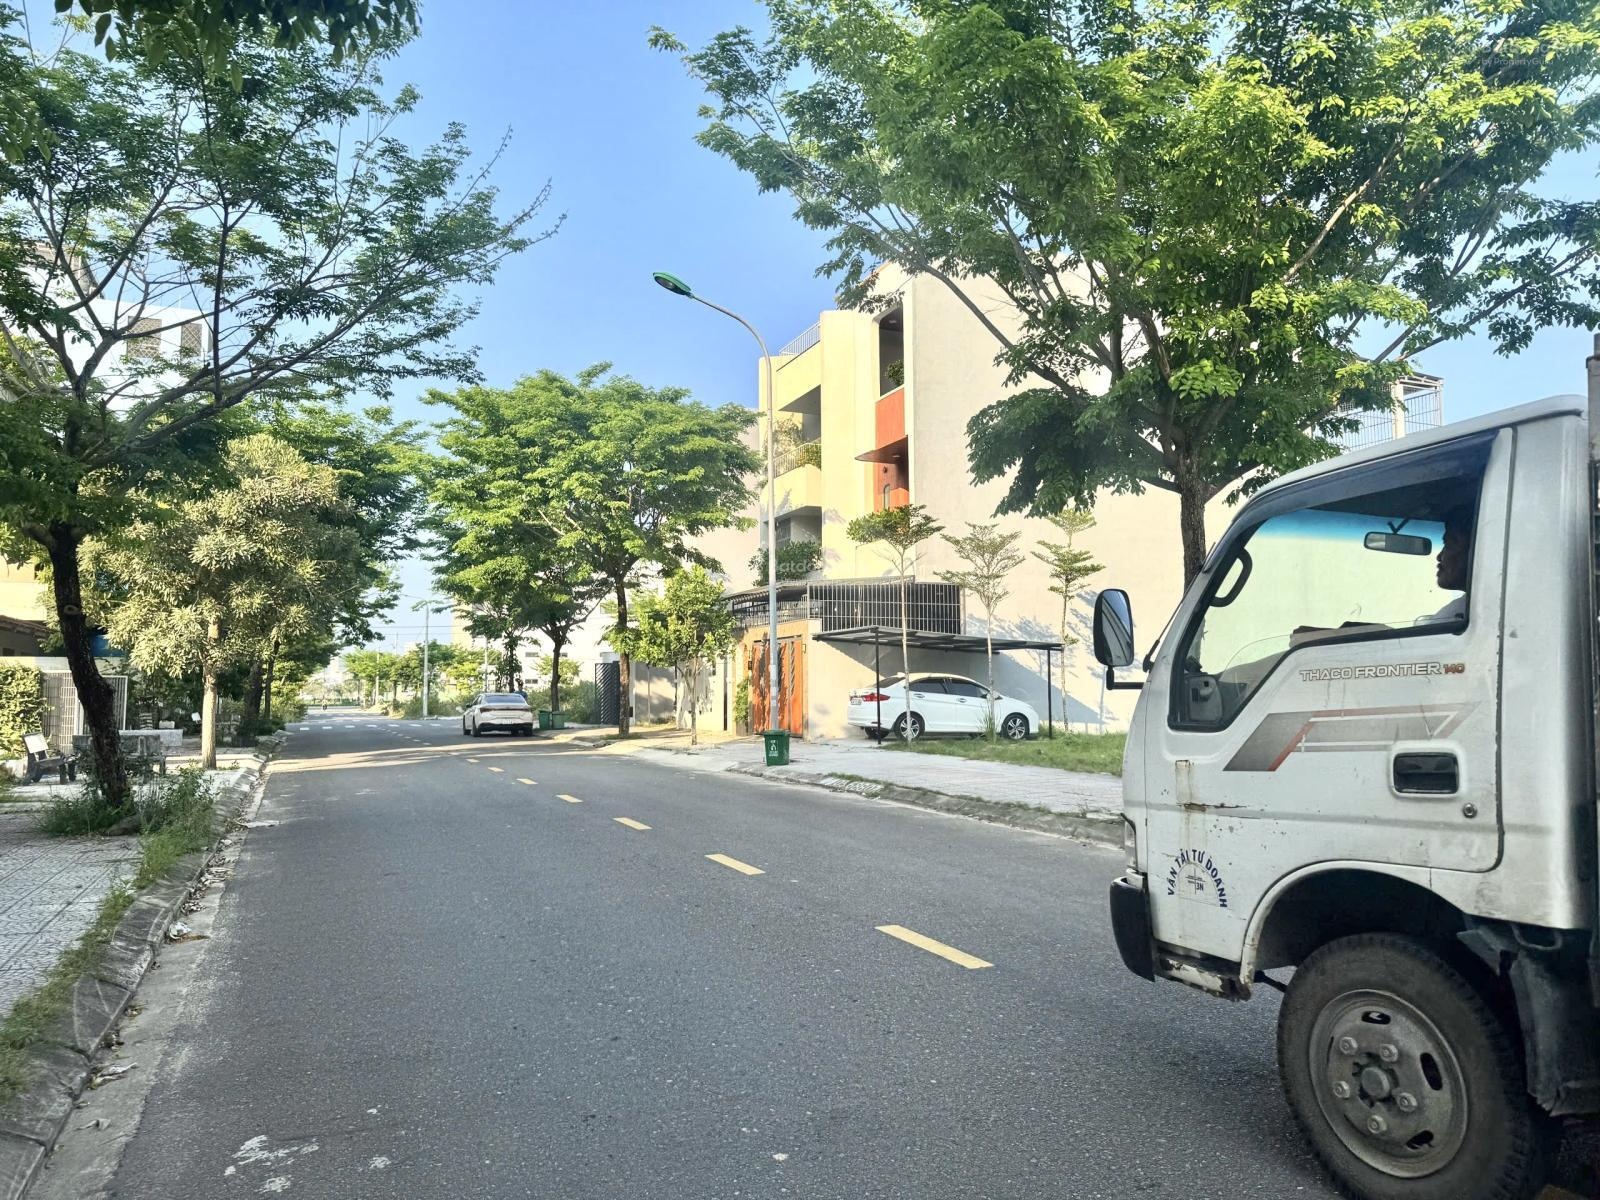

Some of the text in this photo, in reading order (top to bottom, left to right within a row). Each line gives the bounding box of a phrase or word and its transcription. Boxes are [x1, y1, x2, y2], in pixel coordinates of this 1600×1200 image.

[1300, 662, 1466, 682] THACO FRONTIER 140
